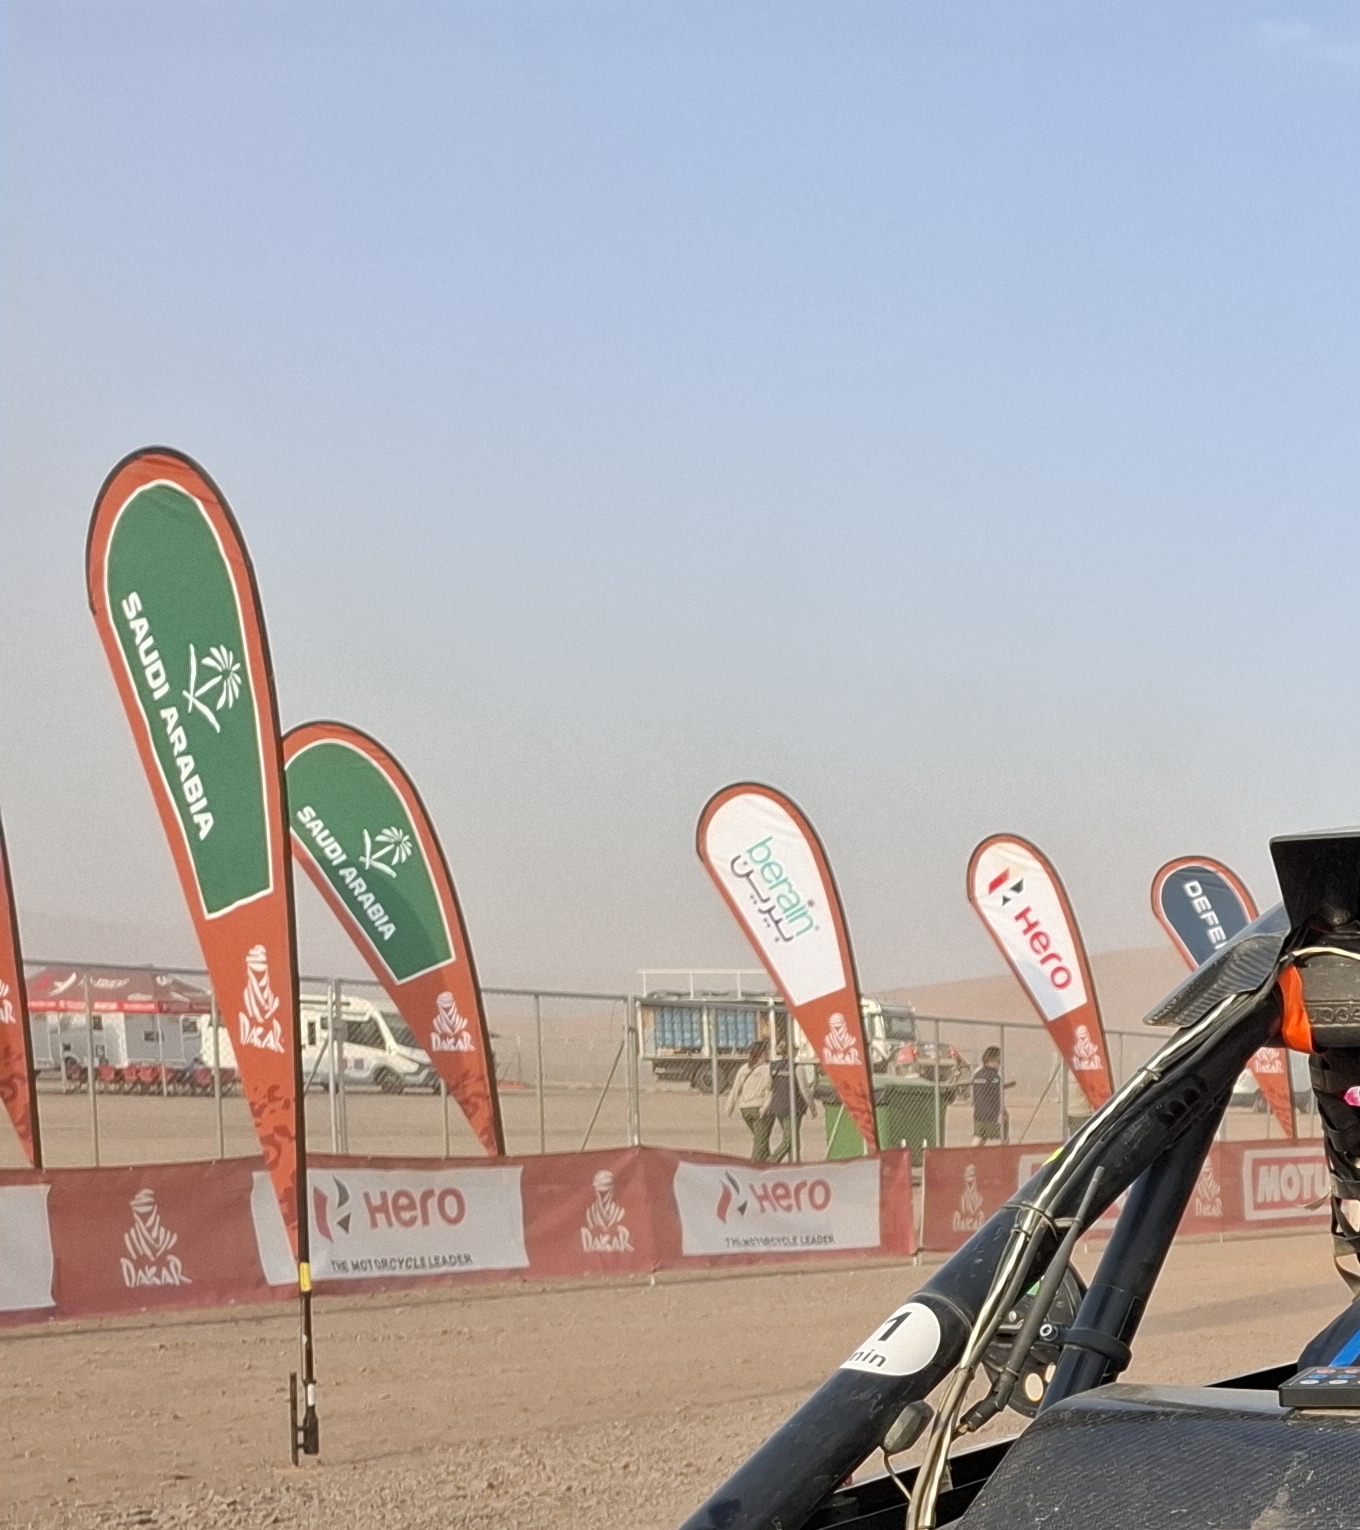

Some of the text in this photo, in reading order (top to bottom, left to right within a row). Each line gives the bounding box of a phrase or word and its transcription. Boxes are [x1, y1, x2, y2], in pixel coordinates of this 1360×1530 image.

[122, 592, 214, 841] SAUDI ARABIA
[297, 805, 396, 941] SAUDI ARABIA
[746, 836, 815, 937] berain
[1014, 906, 1073, 990] Hero
[239, 1011, 284, 1054] DAKAR
[431, 1031, 475, 1052] DAKAR
[363, 1186, 466, 1229] Hero
[749, 1179, 831, 1213] Hero
[580, 1226, 634, 1253] DAKAR
[121, 1256, 192, 1287] DAKAR
[350, 1255, 425, 1271] MOTORCYCLE
[427, 1253, 473, 1268] LEADER
[878, 1312, 912, 1342] 1
